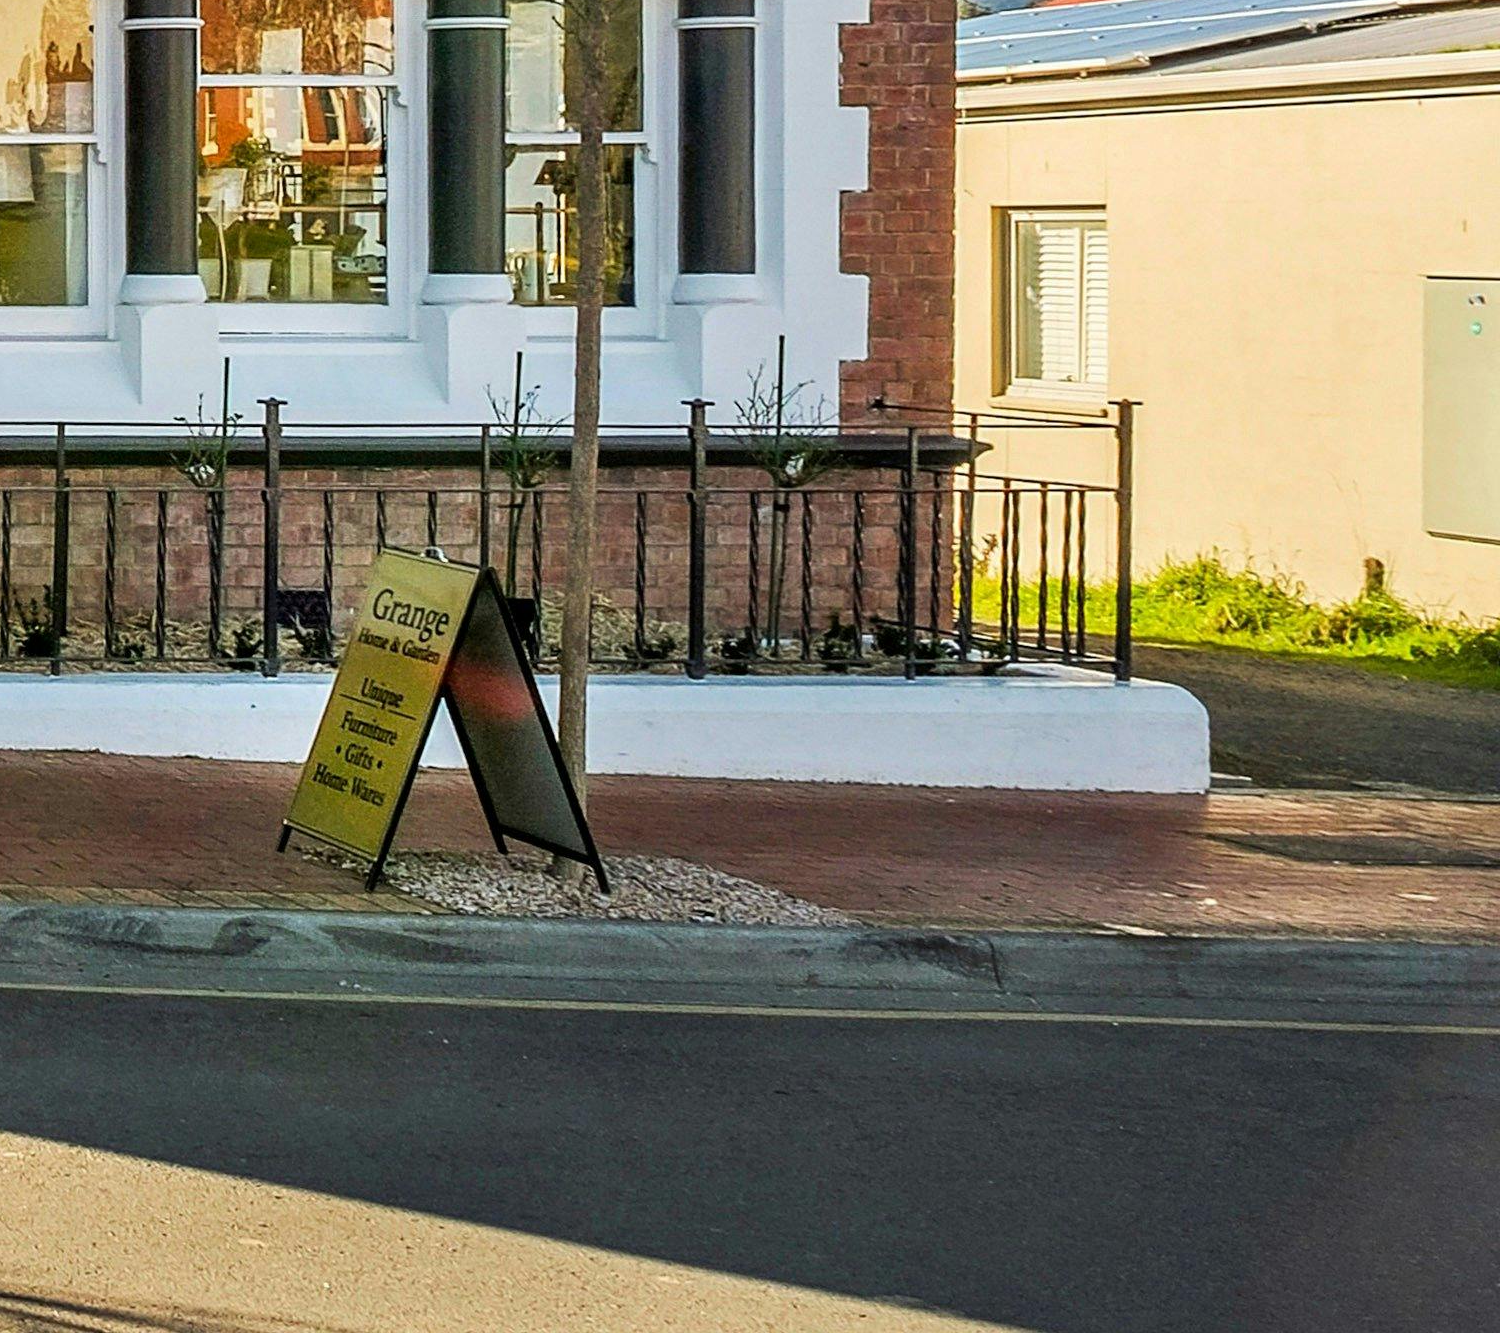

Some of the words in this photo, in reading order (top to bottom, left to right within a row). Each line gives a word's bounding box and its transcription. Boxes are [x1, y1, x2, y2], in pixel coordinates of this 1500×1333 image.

[373, 588, 450, 643] Grange
[358, 626, 391, 650] Home
[389, 636, 401, 653] &
[402, 639, 441, 665] Garden
[361, 677, 404, 710] Unique
[341, 710, 398, 747] Furniture
[312, 762, 349, 792] Home
[350, 776, 386, 806] Wares
